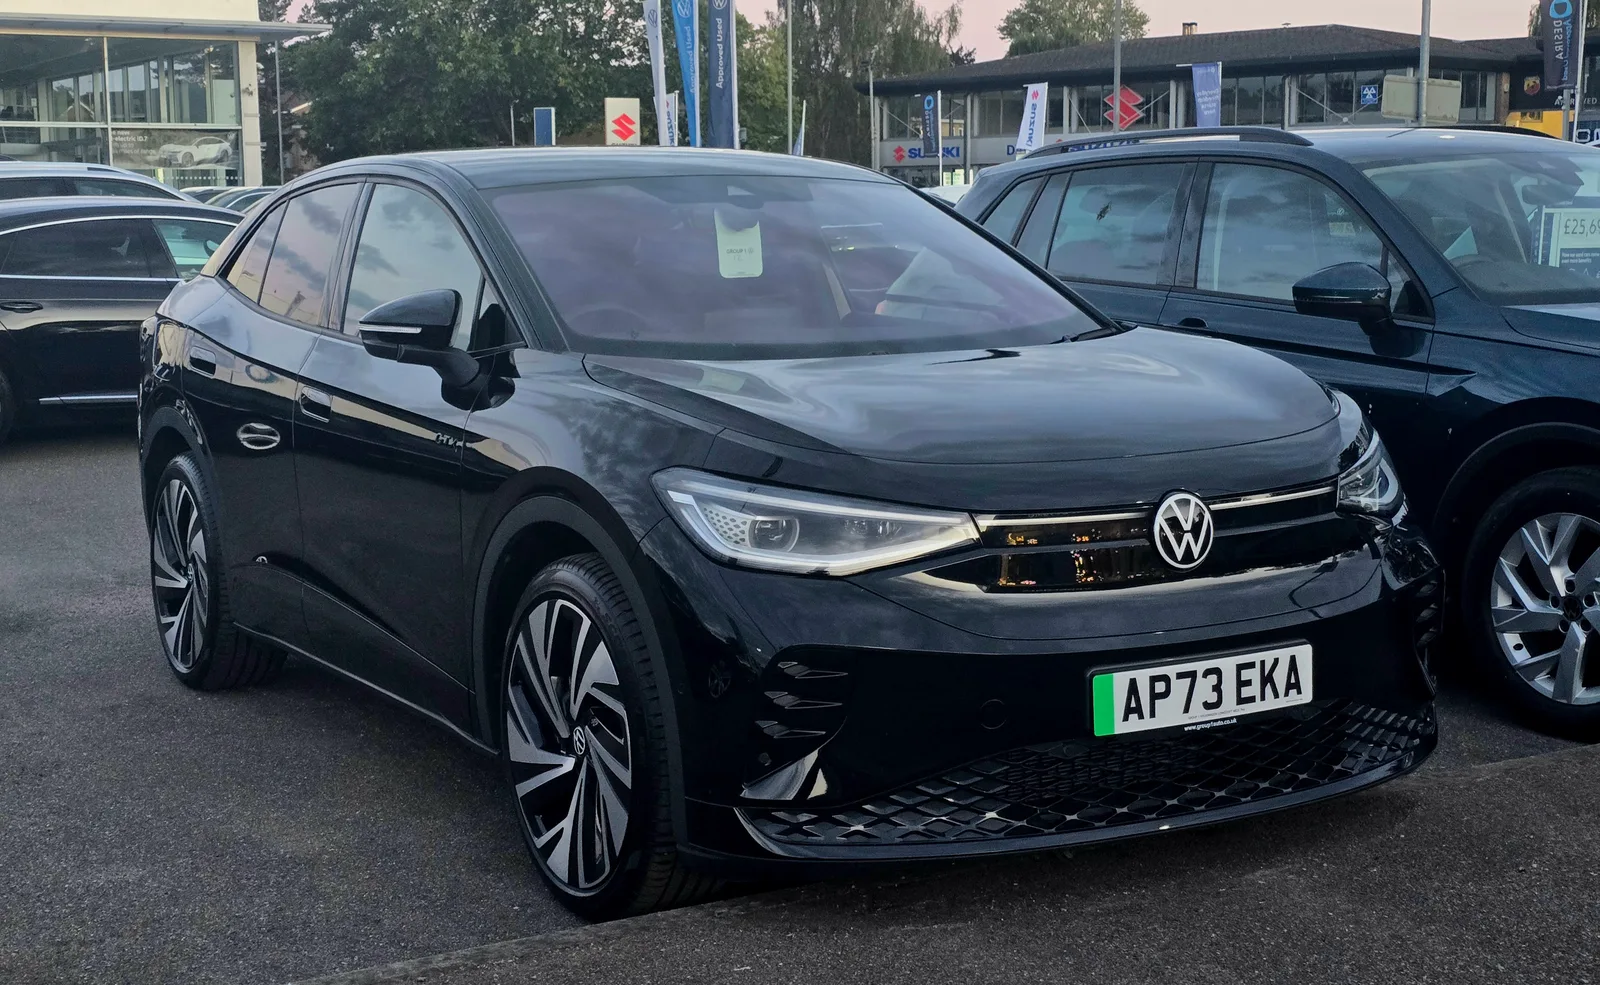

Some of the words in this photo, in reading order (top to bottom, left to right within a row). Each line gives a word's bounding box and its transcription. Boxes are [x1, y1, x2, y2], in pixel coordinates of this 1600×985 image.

[688, 50, 696, 94] Approved
[716, 44, 724, 89] Approved
[1026, 103, 1037, 147] SUZUKI
[1122, 666, 1224, 722] AP73
[1235, 654, 1303, 706] EKA
[1183, 717, 1238, 732] www.group1auto.co.uk
